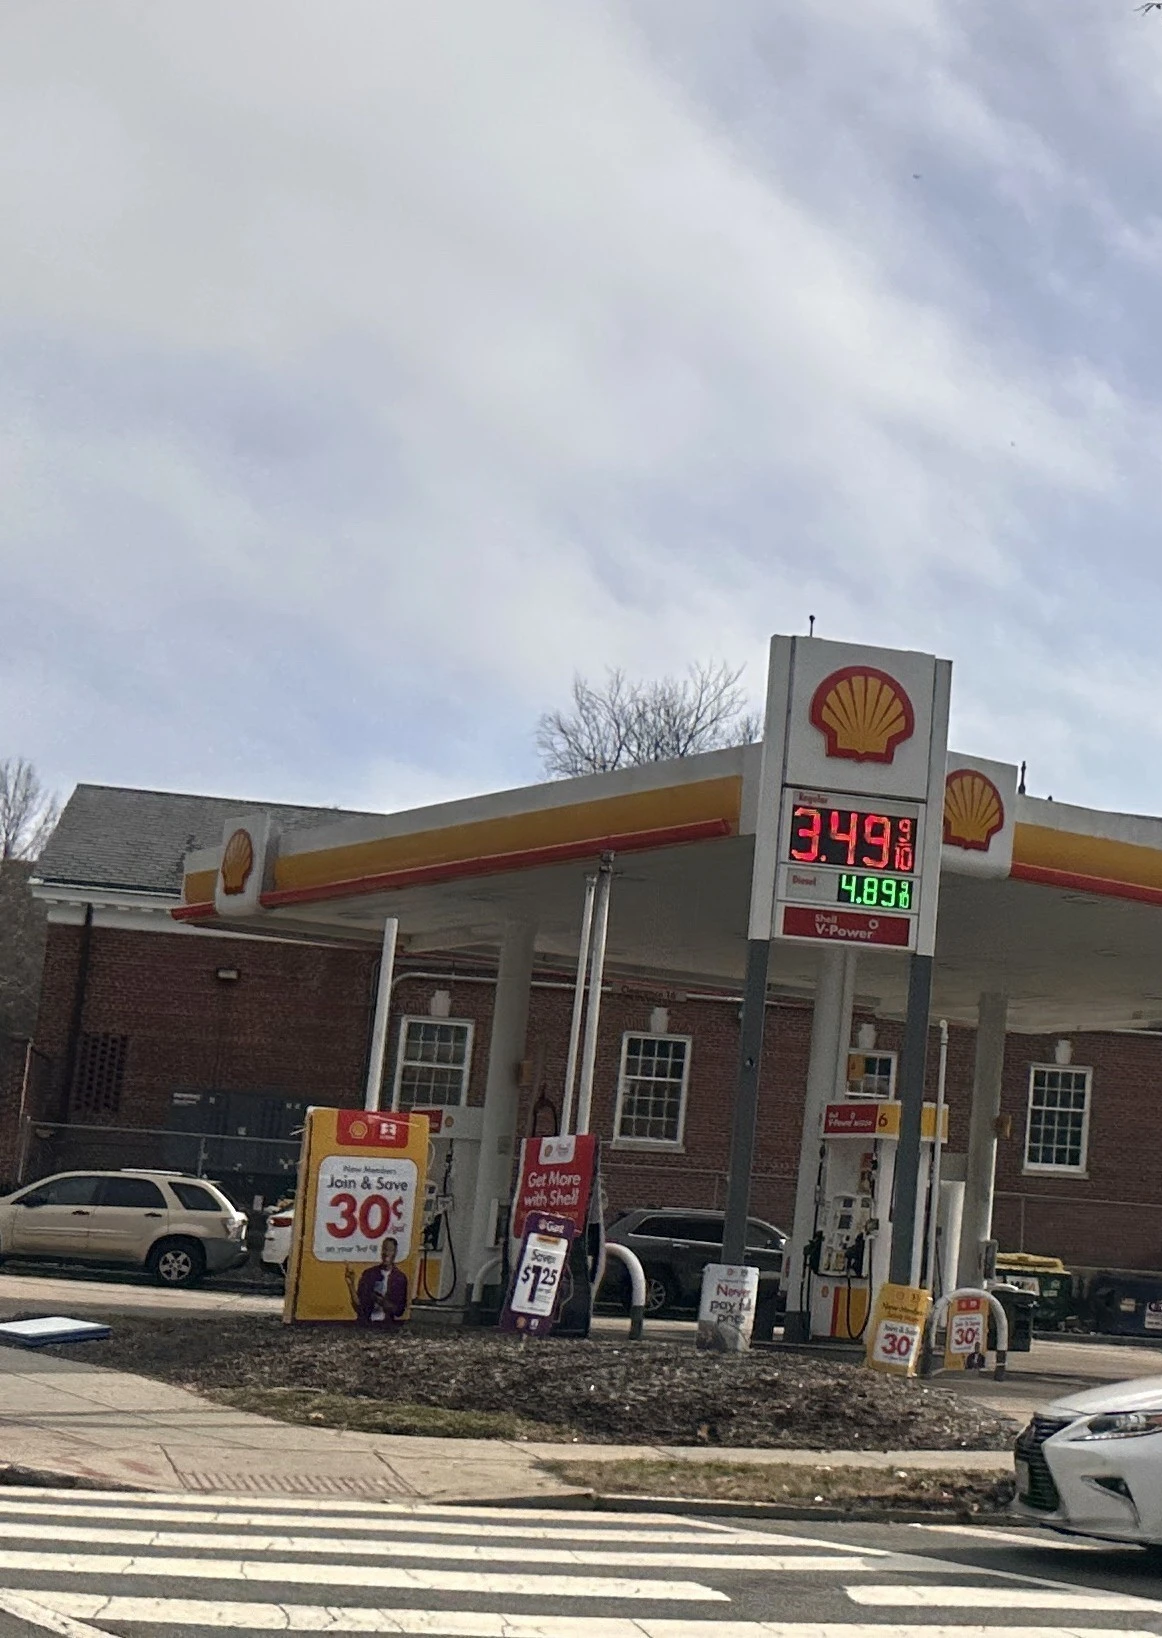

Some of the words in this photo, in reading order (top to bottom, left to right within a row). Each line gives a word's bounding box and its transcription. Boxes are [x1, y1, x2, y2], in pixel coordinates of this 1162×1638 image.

[792, 874, 817, 887] Diesel
[815, 914, 838, 923] Shell
[815, 923, 873, 940] V-Power
[878, 1112, 889, 1128] 6
[326, 1175, 356, 1190] Join
[360, 1177, 372, 1190] &
[376, 1177, 409, 1191] Save
[528, 1172, 547, 1188] Get
[549, 1170, 581, 1186] More
[524, 1190, 548, 1207] with
[549, 1187, 580, 1207] Shell
[716, 1283, 751, 1298] Never
[710, 1300, 736, 1314] pay
